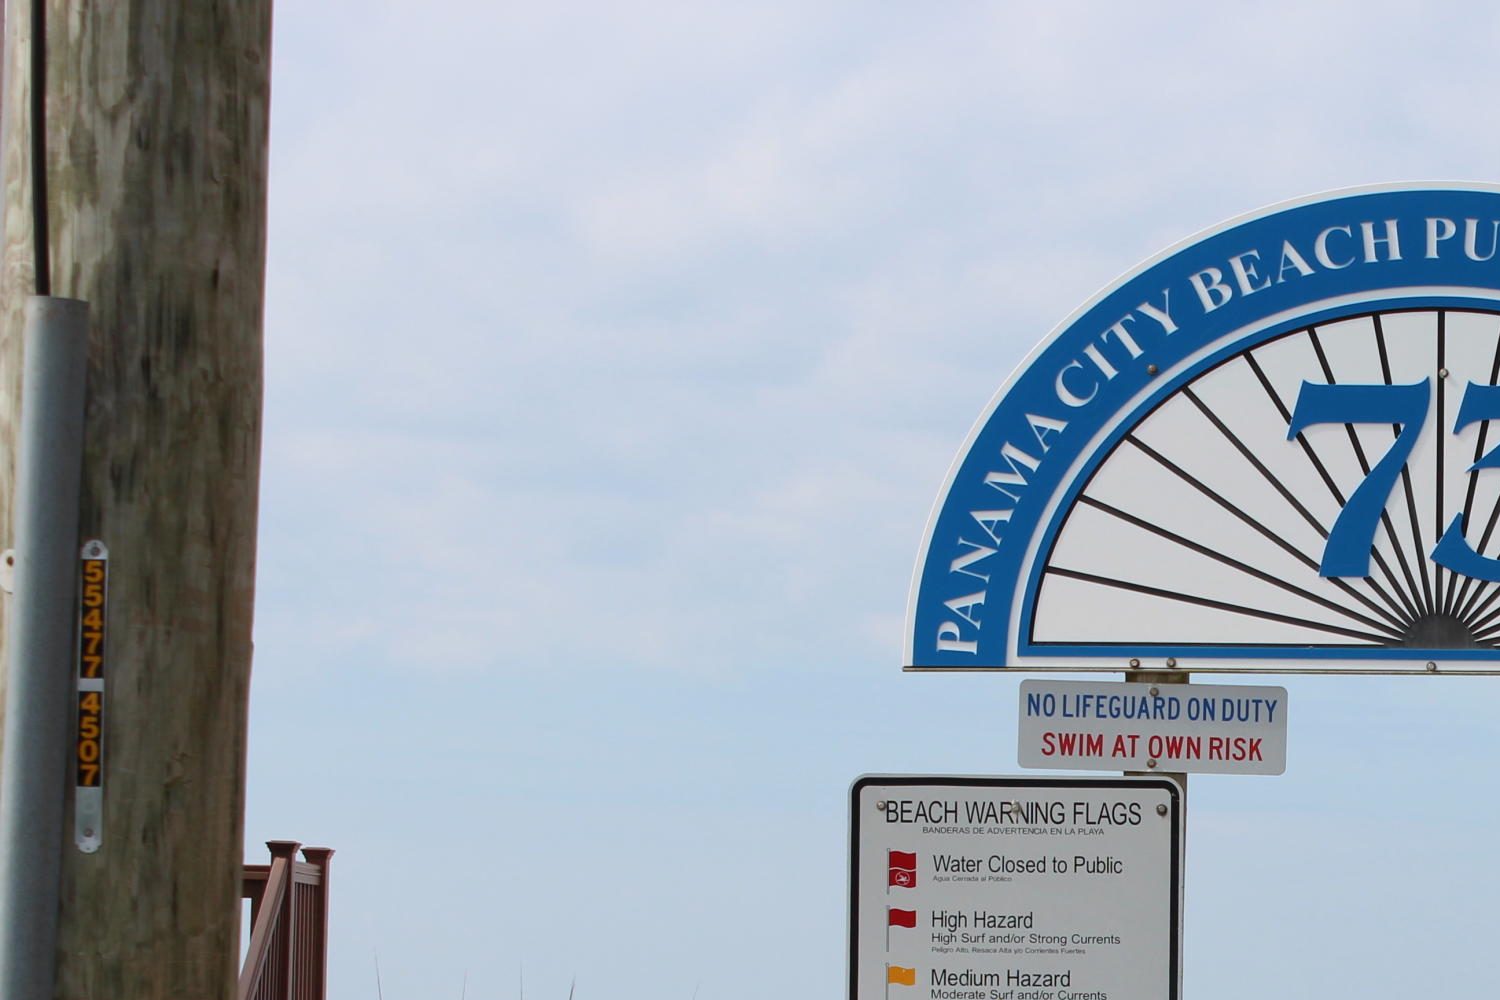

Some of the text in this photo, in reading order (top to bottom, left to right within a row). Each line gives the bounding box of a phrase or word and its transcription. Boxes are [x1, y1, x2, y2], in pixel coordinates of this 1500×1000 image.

[936, 413, 1068, 655] PANAMA
[1055, 289, 1180, 408] CITY
[1188, 218, 1403, 314] BEACH
[1027, 693, 1278, 723] NO LIFEGUARD ON DUTY
[1041, 732, 1263, 761] SWIM AT OWN RISK
[886, 800, 1142, 826] BEACH WARNING FLAGS
[932, 855, 1123, 874] Water Closed to Public
[932, 910, 1033, 932] High Hazard
[932, 933, 1120, 946] High Surf and/or Strong Currents
[931, 968, 1071, 987] Medium Hazard
[930, 990, 1107, 1000] Moderate Surf and/or Currents
